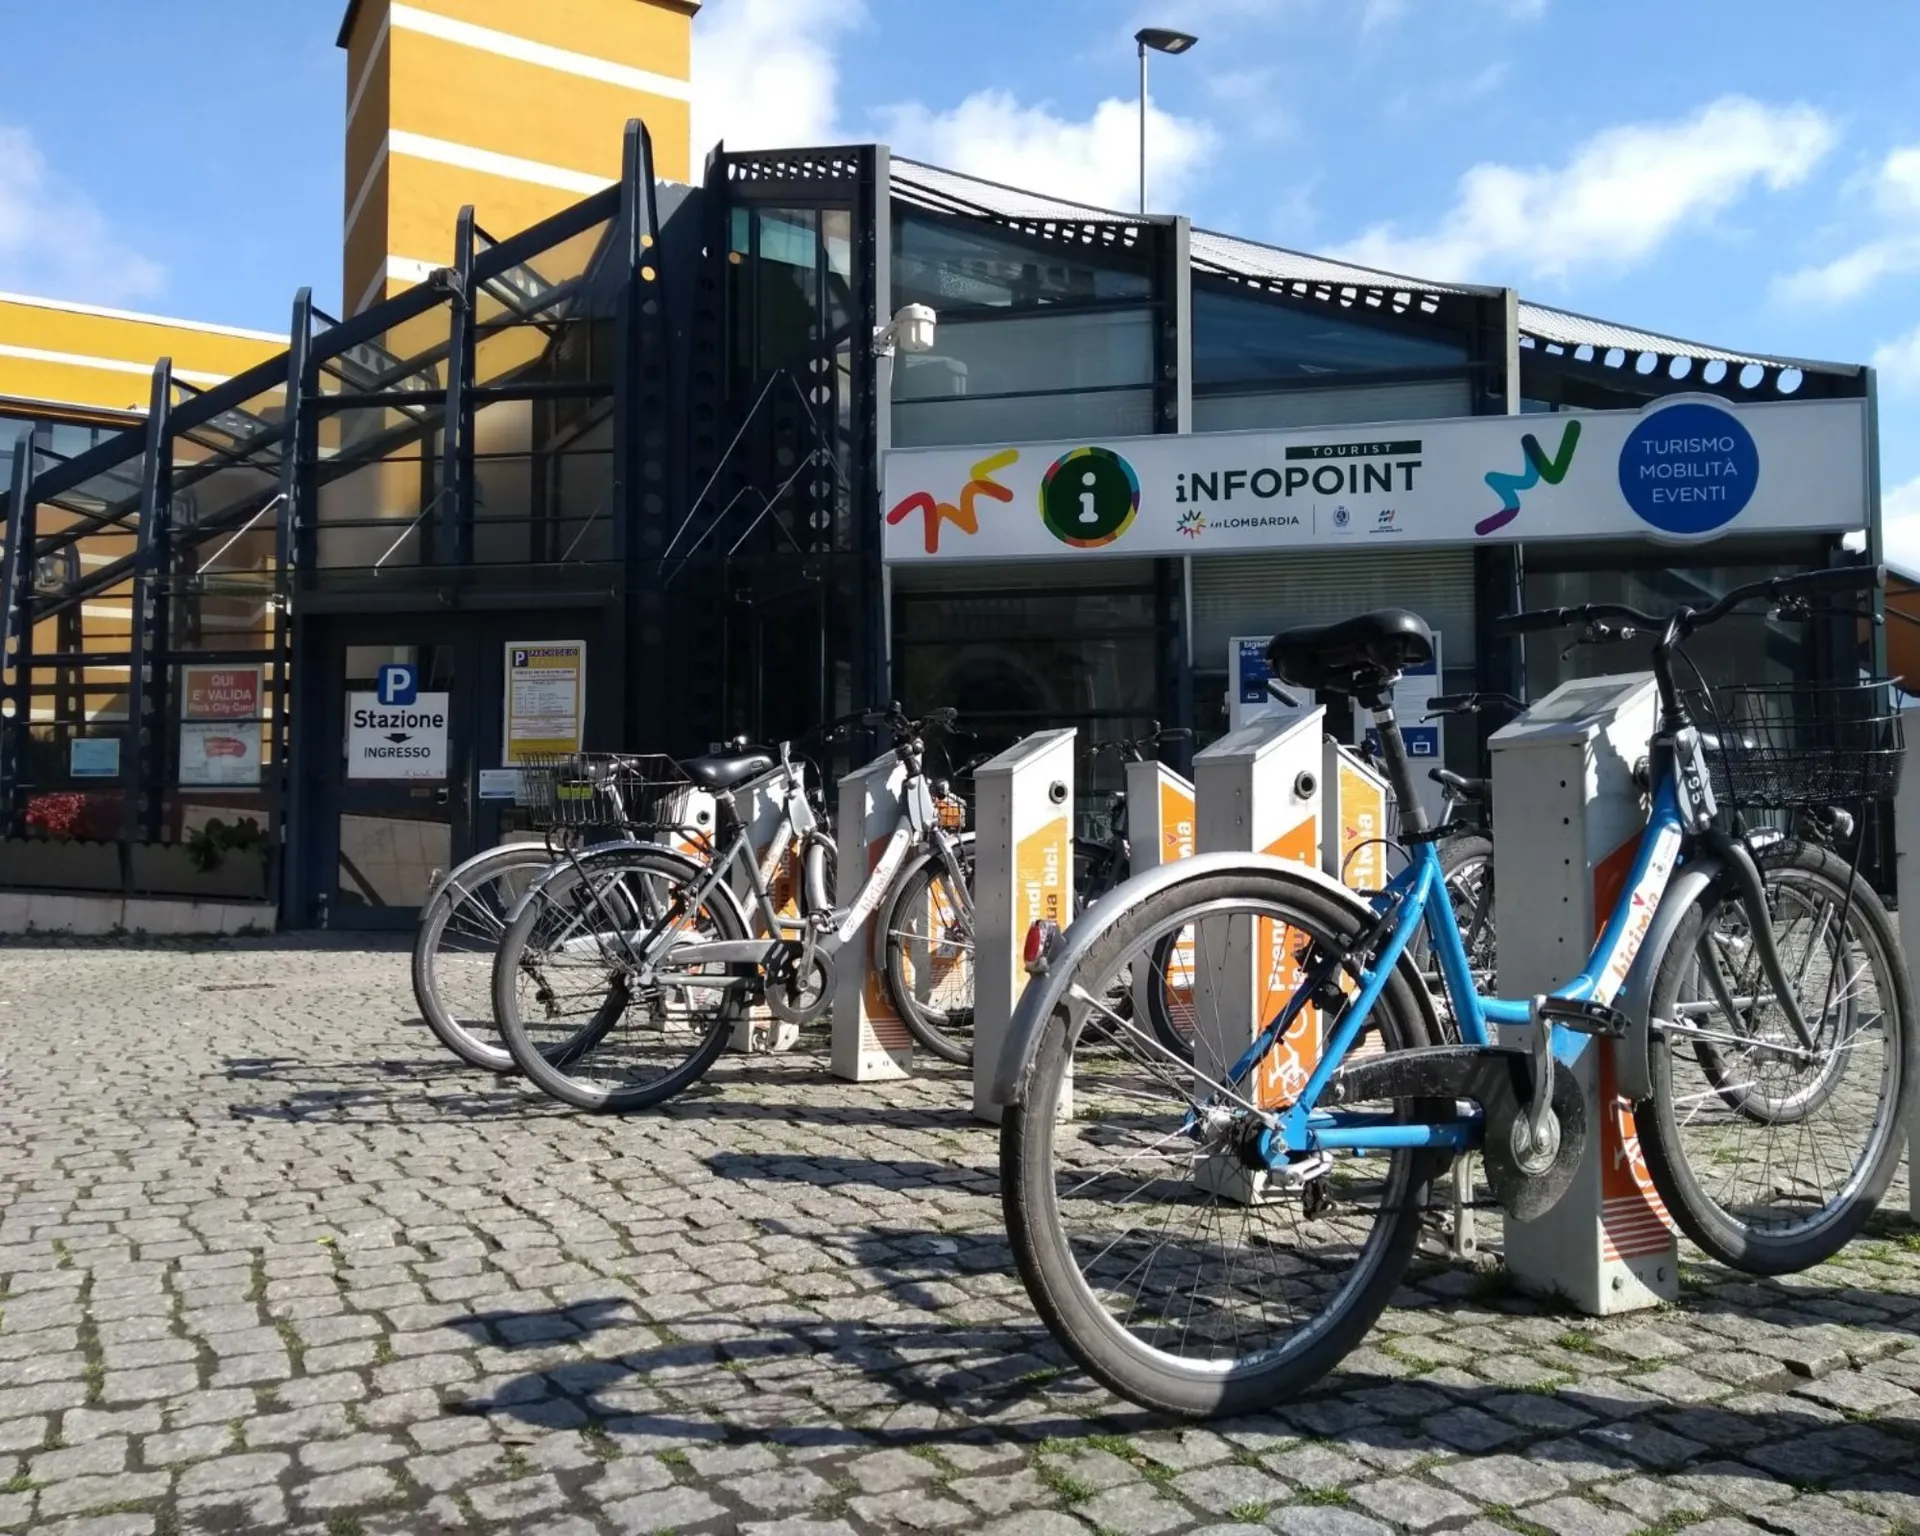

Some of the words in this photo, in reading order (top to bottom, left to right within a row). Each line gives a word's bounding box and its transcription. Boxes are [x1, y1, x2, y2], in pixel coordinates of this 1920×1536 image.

[1311, 443, 1393, 457] TOURIST
[1641, 436, 1735, 455] TURISMO
[1639, 457, 1738, 479] MOBILITÀ
[1652, 485, 1726, 503] EVENTI
[515, 651, 526, 667] P
[211, 674, 234, 687] QUI
[386, 668, 411, 702] P
[207, 689, 252, 700] VALIDA
[188, 703, 210, 712] Park
[212, 702, 230, 714] City
[232, 702, 255, 712] Card
[353, 709, 444, 728] Stazione
[364, 746, 431, 758] INGRESSO
[1684, 759, 1704, 805] 795
[1046, 893, 1058, 923] ua
[1268, 917, 1286, 991] Pren
